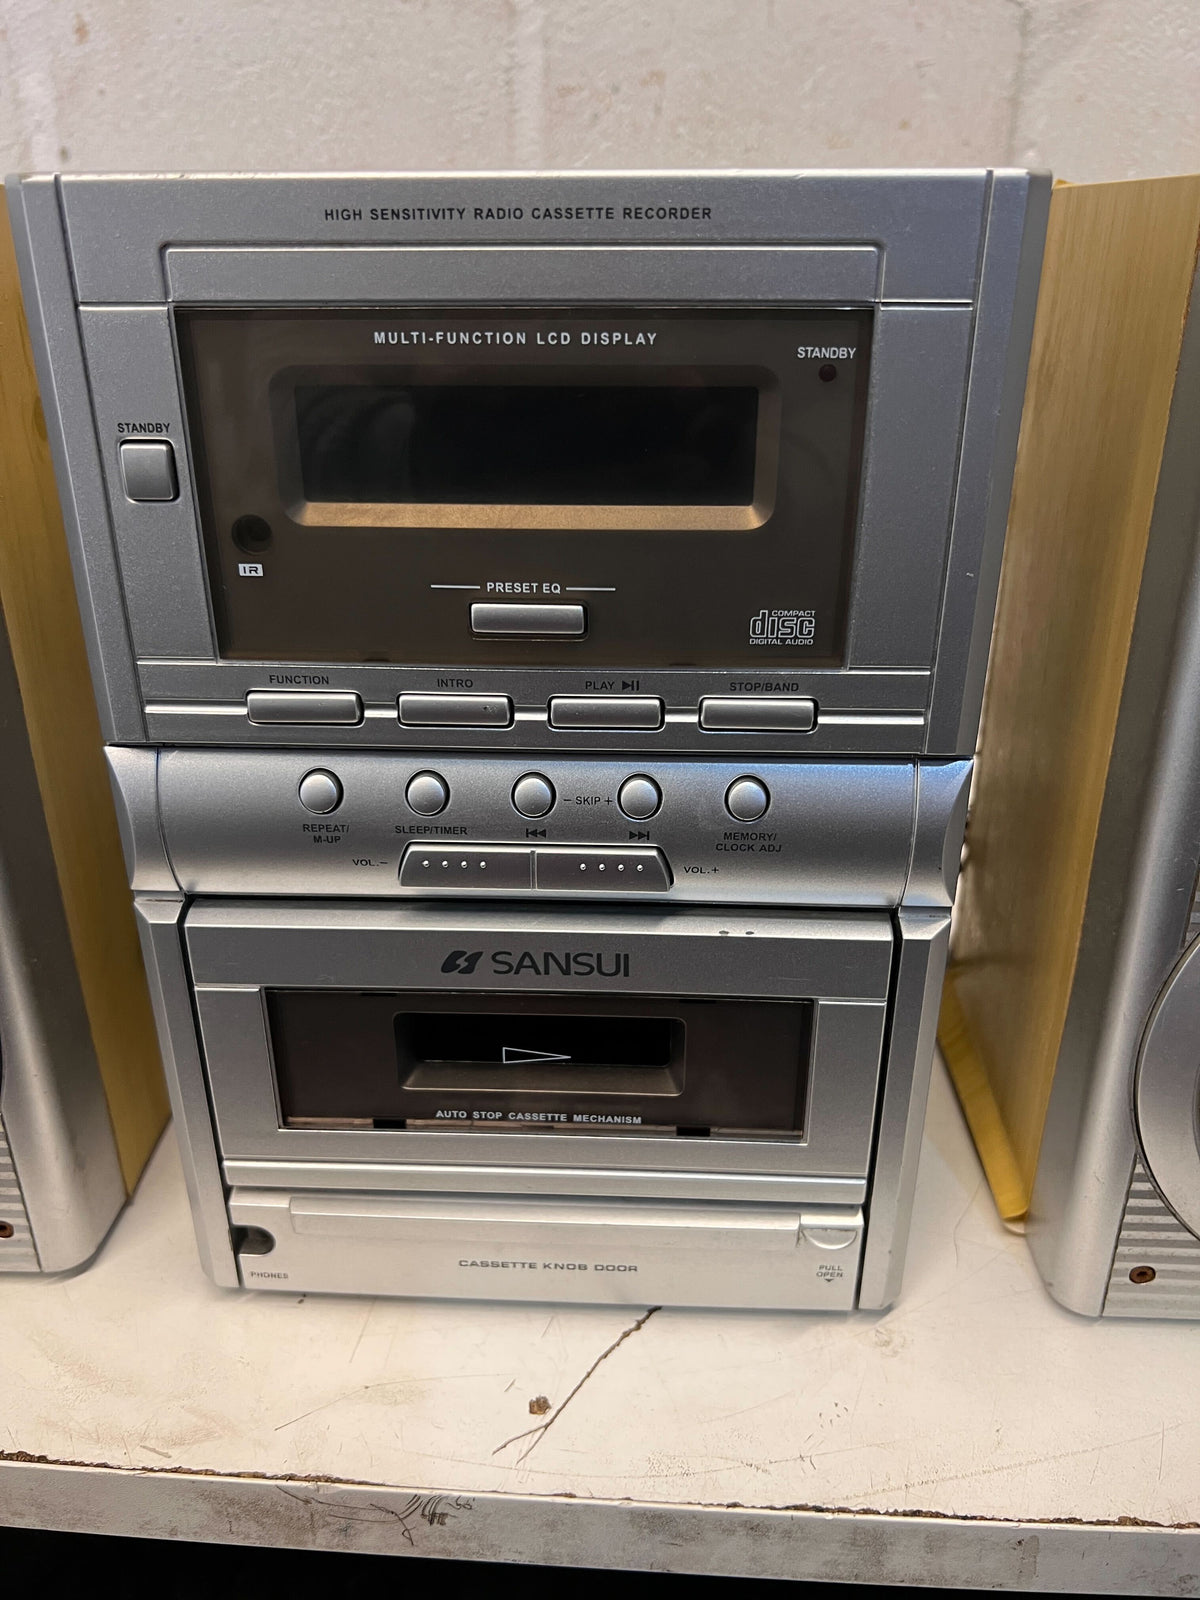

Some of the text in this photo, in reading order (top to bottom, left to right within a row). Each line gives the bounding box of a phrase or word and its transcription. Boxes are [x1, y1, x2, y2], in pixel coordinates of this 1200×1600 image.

[324, 207, 712, 221] HIGH SENSITIVITY RADIO CASSETTE RECORDER
[373, 331, 657, 346] MULTI-FUNCTION LCD DISPLAY
[797, 346, 857, 359] STANDBY
[117, 422, 171, 434] STANDBY
[486, 582, 562, 595] PRESET EQ
[785, 638, 814, 646] AUDIO
[269, 674, 330, 686] FUNCTION
[436, 678, 474, 689] INTRO
[585, 680, 615, 691] PLAY
[729, 682, 800, 692] STOP/BAND
[575, 796, 601, 806] SKIP
[302, 823, 351, 834] REPEAT/
[394, 825, 468, 836] SLEEP/TIMER
[313, 835, 342, 844] M-UP
[723, 831, 778, 842] MEMORY/
[715, 842, 783, 853] CLOCK ADJ
[491, 951, 630, 977] SANSUI
[435, 1109, 642, 1125] AUTO STOP CASSETTE MECHANISM
[458, 1259, 638, 1272] CASSETTE KNOB DOOR
[250, 1271, 290, 1279] PHONES
